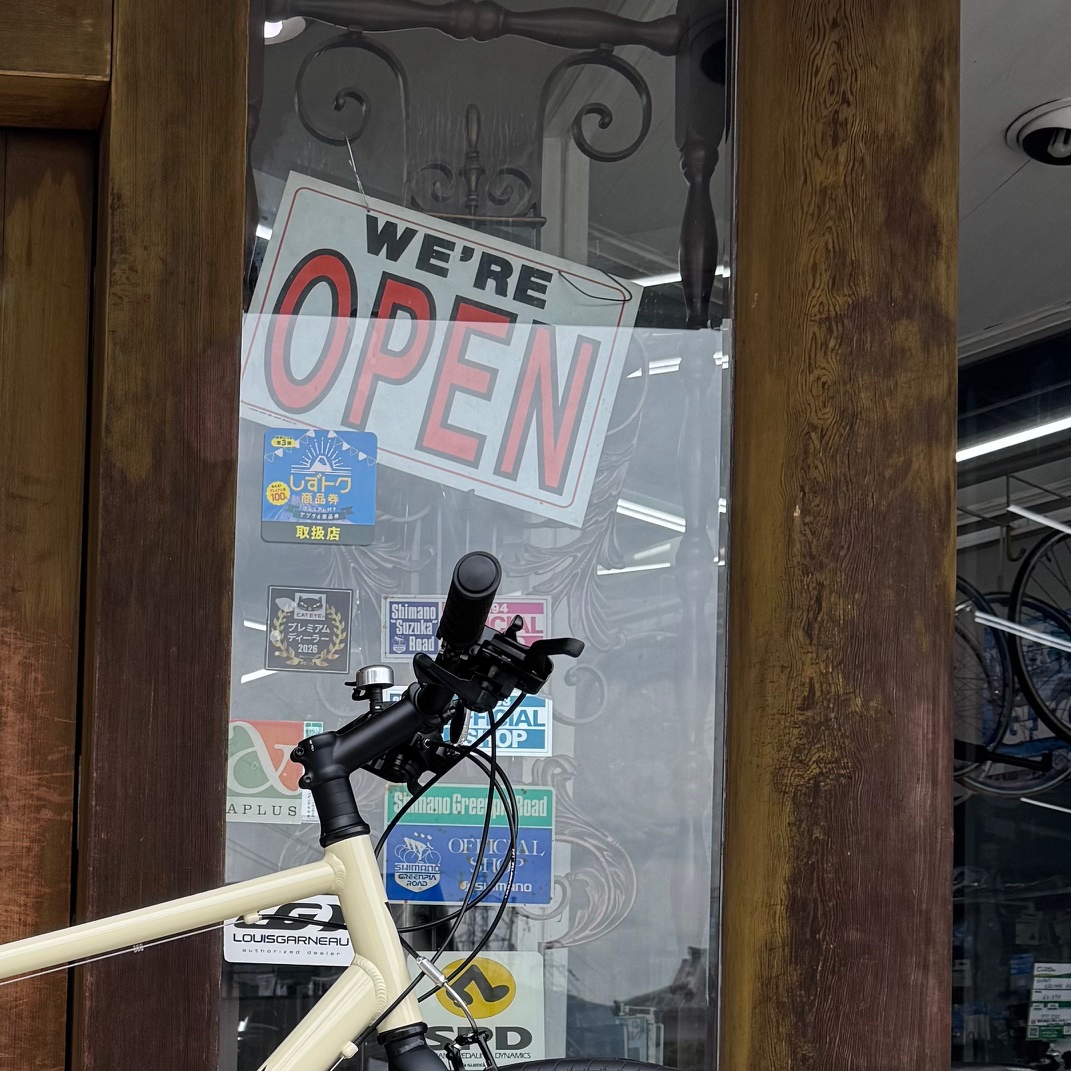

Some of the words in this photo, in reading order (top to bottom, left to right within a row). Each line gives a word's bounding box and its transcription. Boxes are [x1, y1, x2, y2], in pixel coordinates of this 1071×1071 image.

[366, 214, 553, 309] WE'RE
[264, 248, 602, 495] OPEN
[290, 472, 351, 494] しずトク
[296, 525, 341, 541] 取扱店
[391, 603, 436, 620] Shimano
[288, 622, 331, 633] プレミアム
[287, 633, 330, 642] ディーラー
[409, 636, 435, 652] Road
[298, 644, 318, 653] 2026
[226, 803, 298, 817] APLUS
[394, 863, 441, 872] SHIMANO
[233, 933, 350, 947] LOUISGARNEAU
